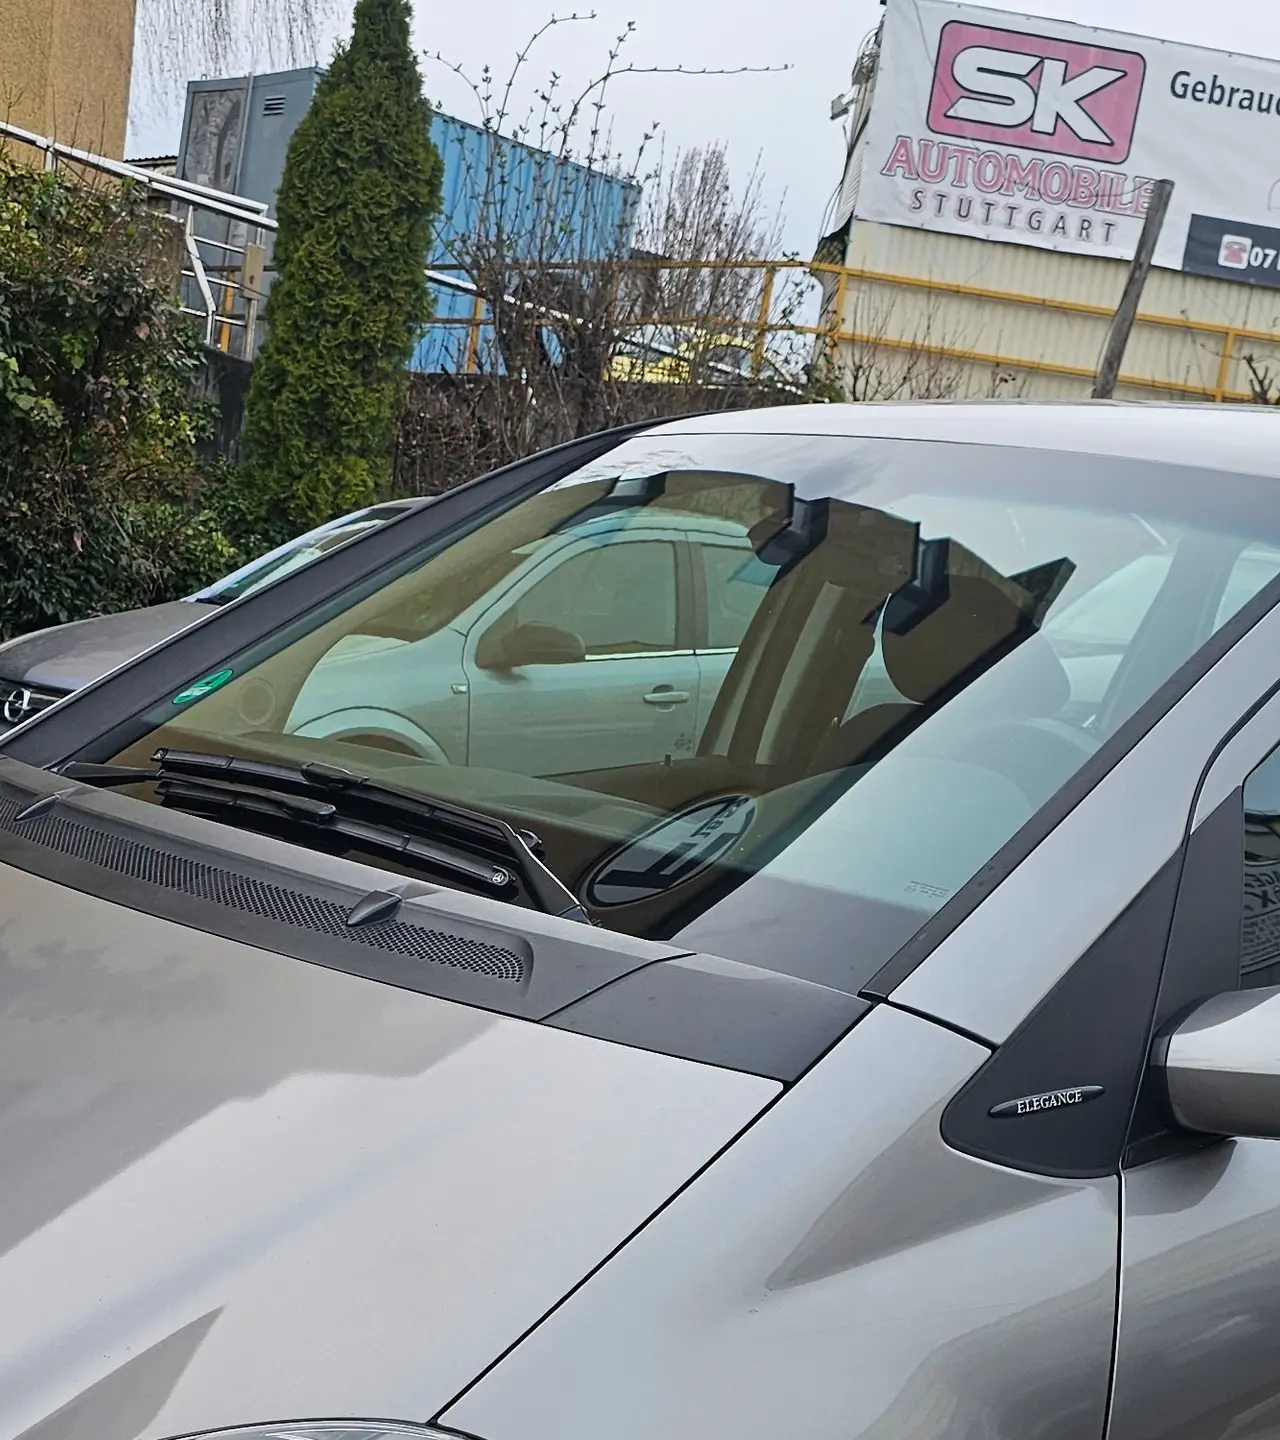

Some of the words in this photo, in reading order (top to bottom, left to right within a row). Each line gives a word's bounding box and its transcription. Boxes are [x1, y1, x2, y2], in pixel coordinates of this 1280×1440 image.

[943, 45, 1128, 146] SK
[880, 136, 1155, 218] AUTOMOBILE
[910, 190, 1117, 244] STUTTGART
[1017, 1089, 1083, 1114] ELEGANCE
